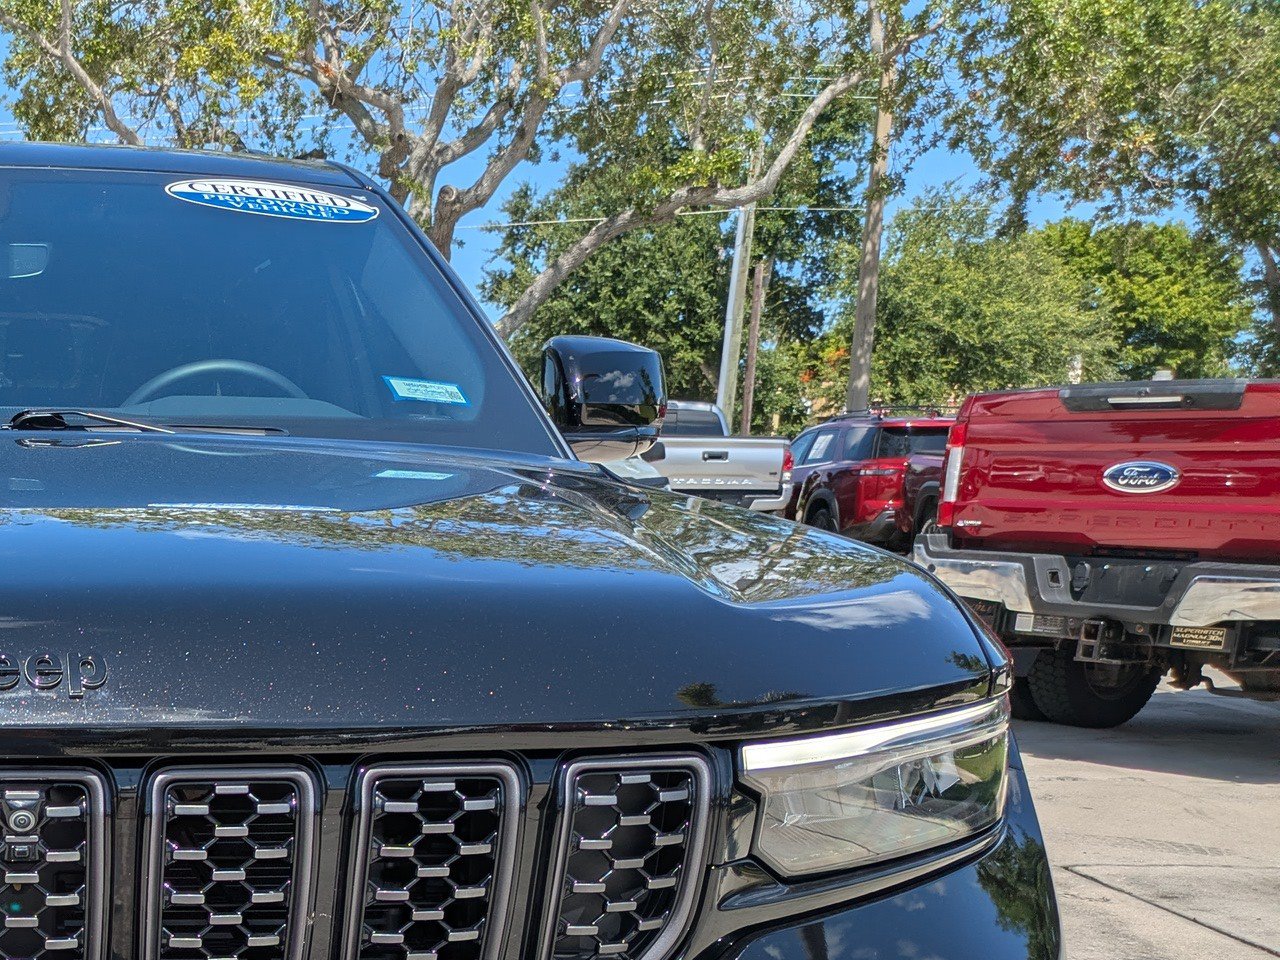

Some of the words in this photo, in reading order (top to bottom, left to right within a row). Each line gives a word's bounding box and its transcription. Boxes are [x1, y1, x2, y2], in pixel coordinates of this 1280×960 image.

[188, 183, 351, 208] CERTIFIED
[202, 194, 349, 215] PRE-OWNED
[228, 201, 335, 218] VEHICLE
[1118, 467, 1159, 485] Ford
